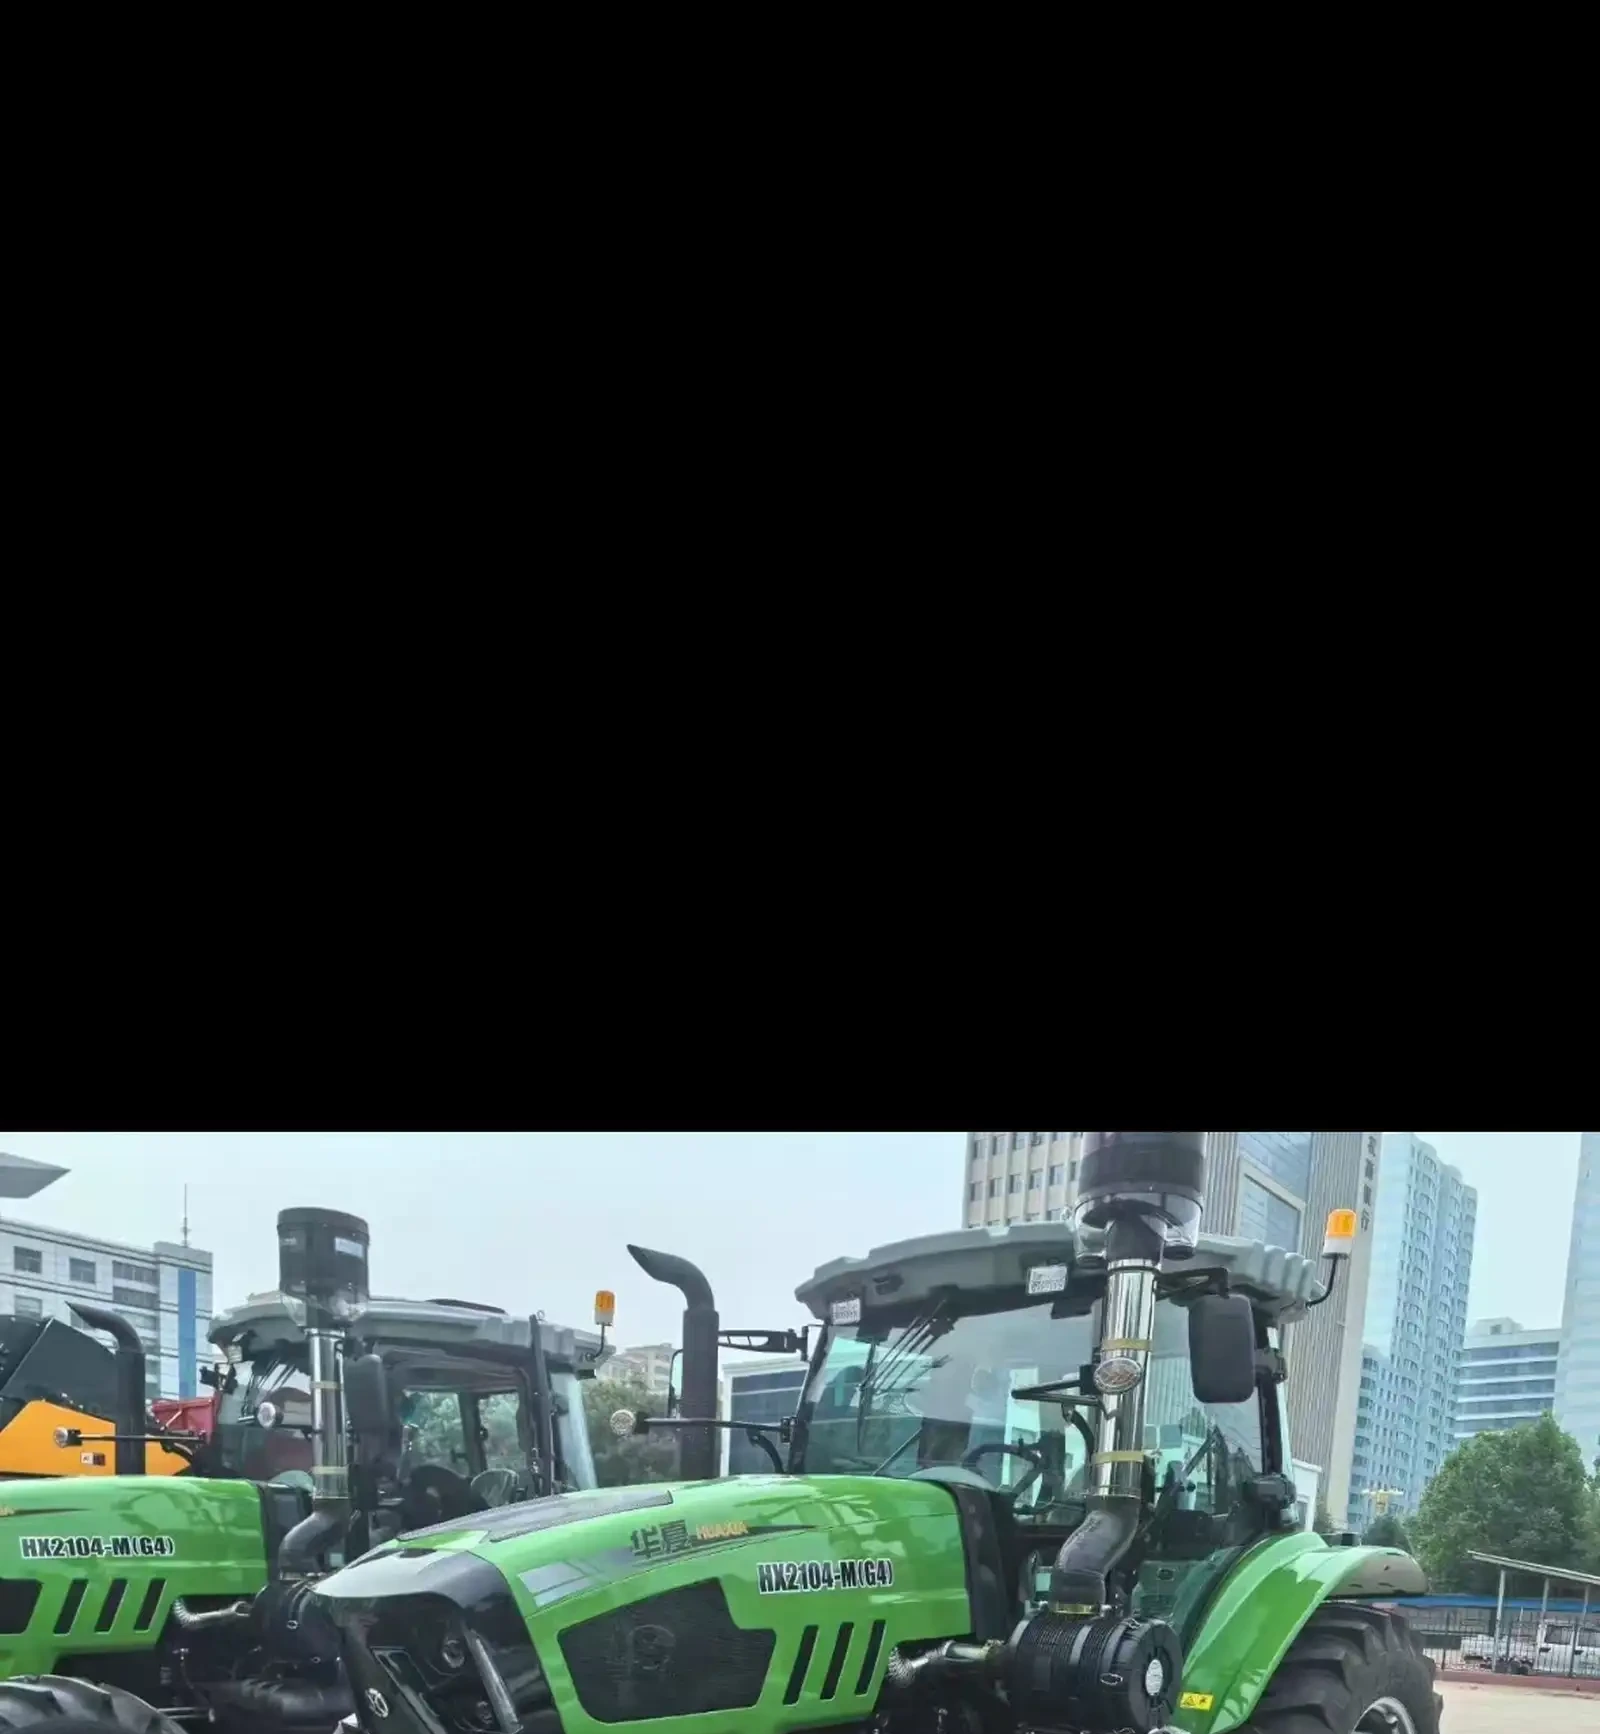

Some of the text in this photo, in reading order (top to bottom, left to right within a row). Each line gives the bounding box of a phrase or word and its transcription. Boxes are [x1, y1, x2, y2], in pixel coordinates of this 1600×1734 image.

[20, 1535, 175, 1558] HX2104-M(G4)
[631, 1519, 692, 1559] 华夏
[757, 1558, 893, 1595] HX2104-M(G4)
